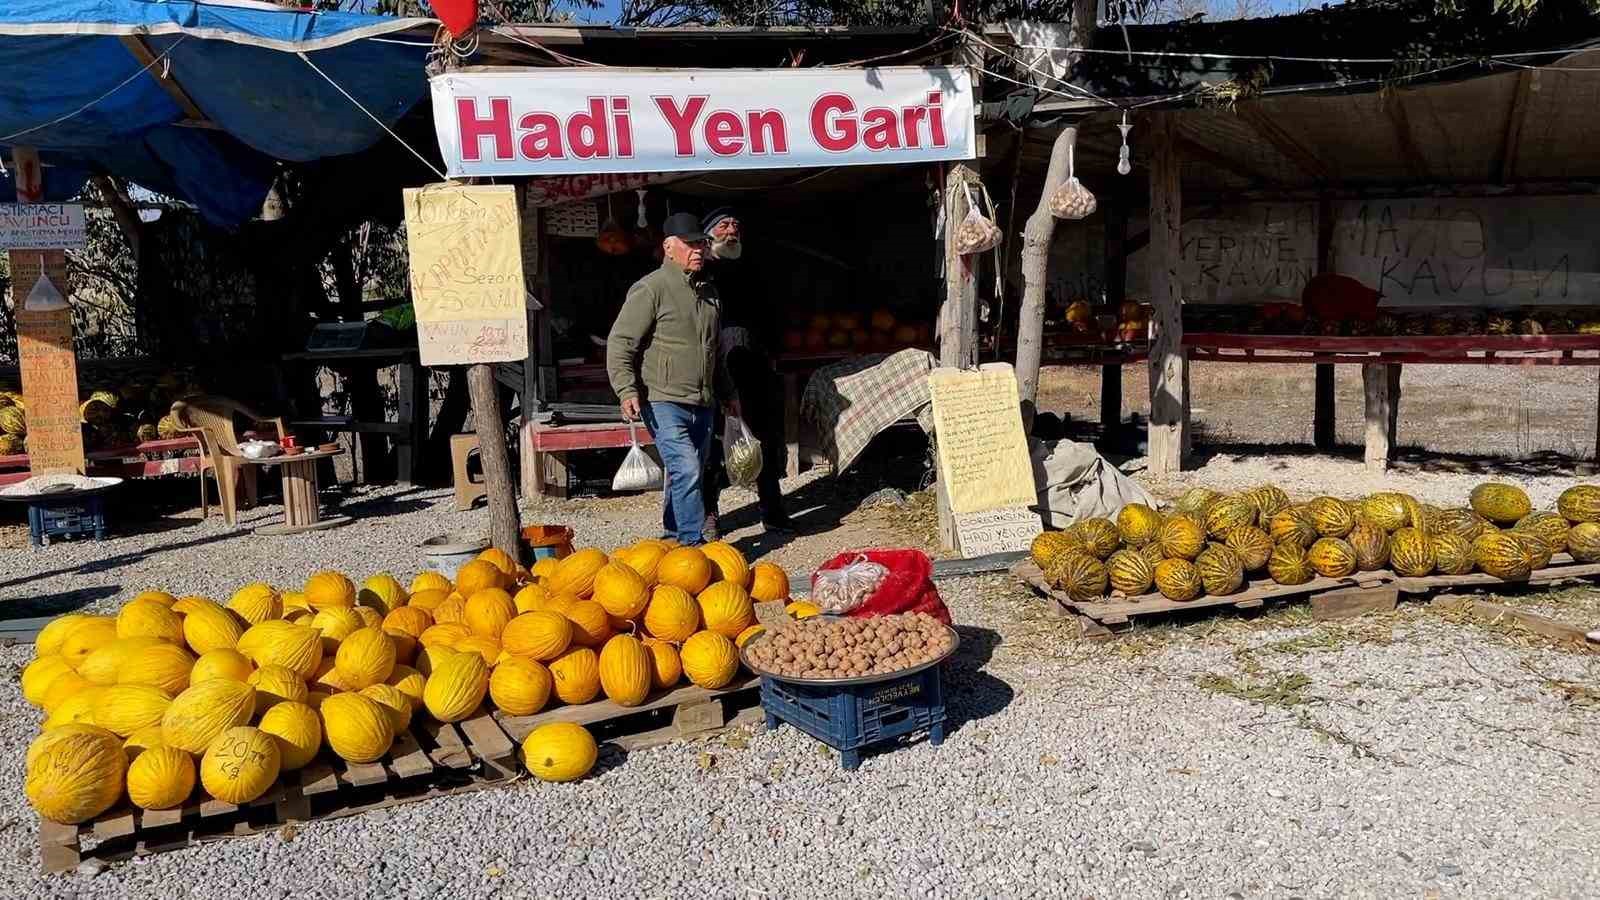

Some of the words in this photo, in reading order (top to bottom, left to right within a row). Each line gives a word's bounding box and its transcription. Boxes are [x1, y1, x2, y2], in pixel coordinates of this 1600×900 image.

[454, 95, 636, 161] Hadi
[650, 94, 791, 157] Yen
[808, 89, 949, 154] Gari
[216, 737, 248, 757] 20
